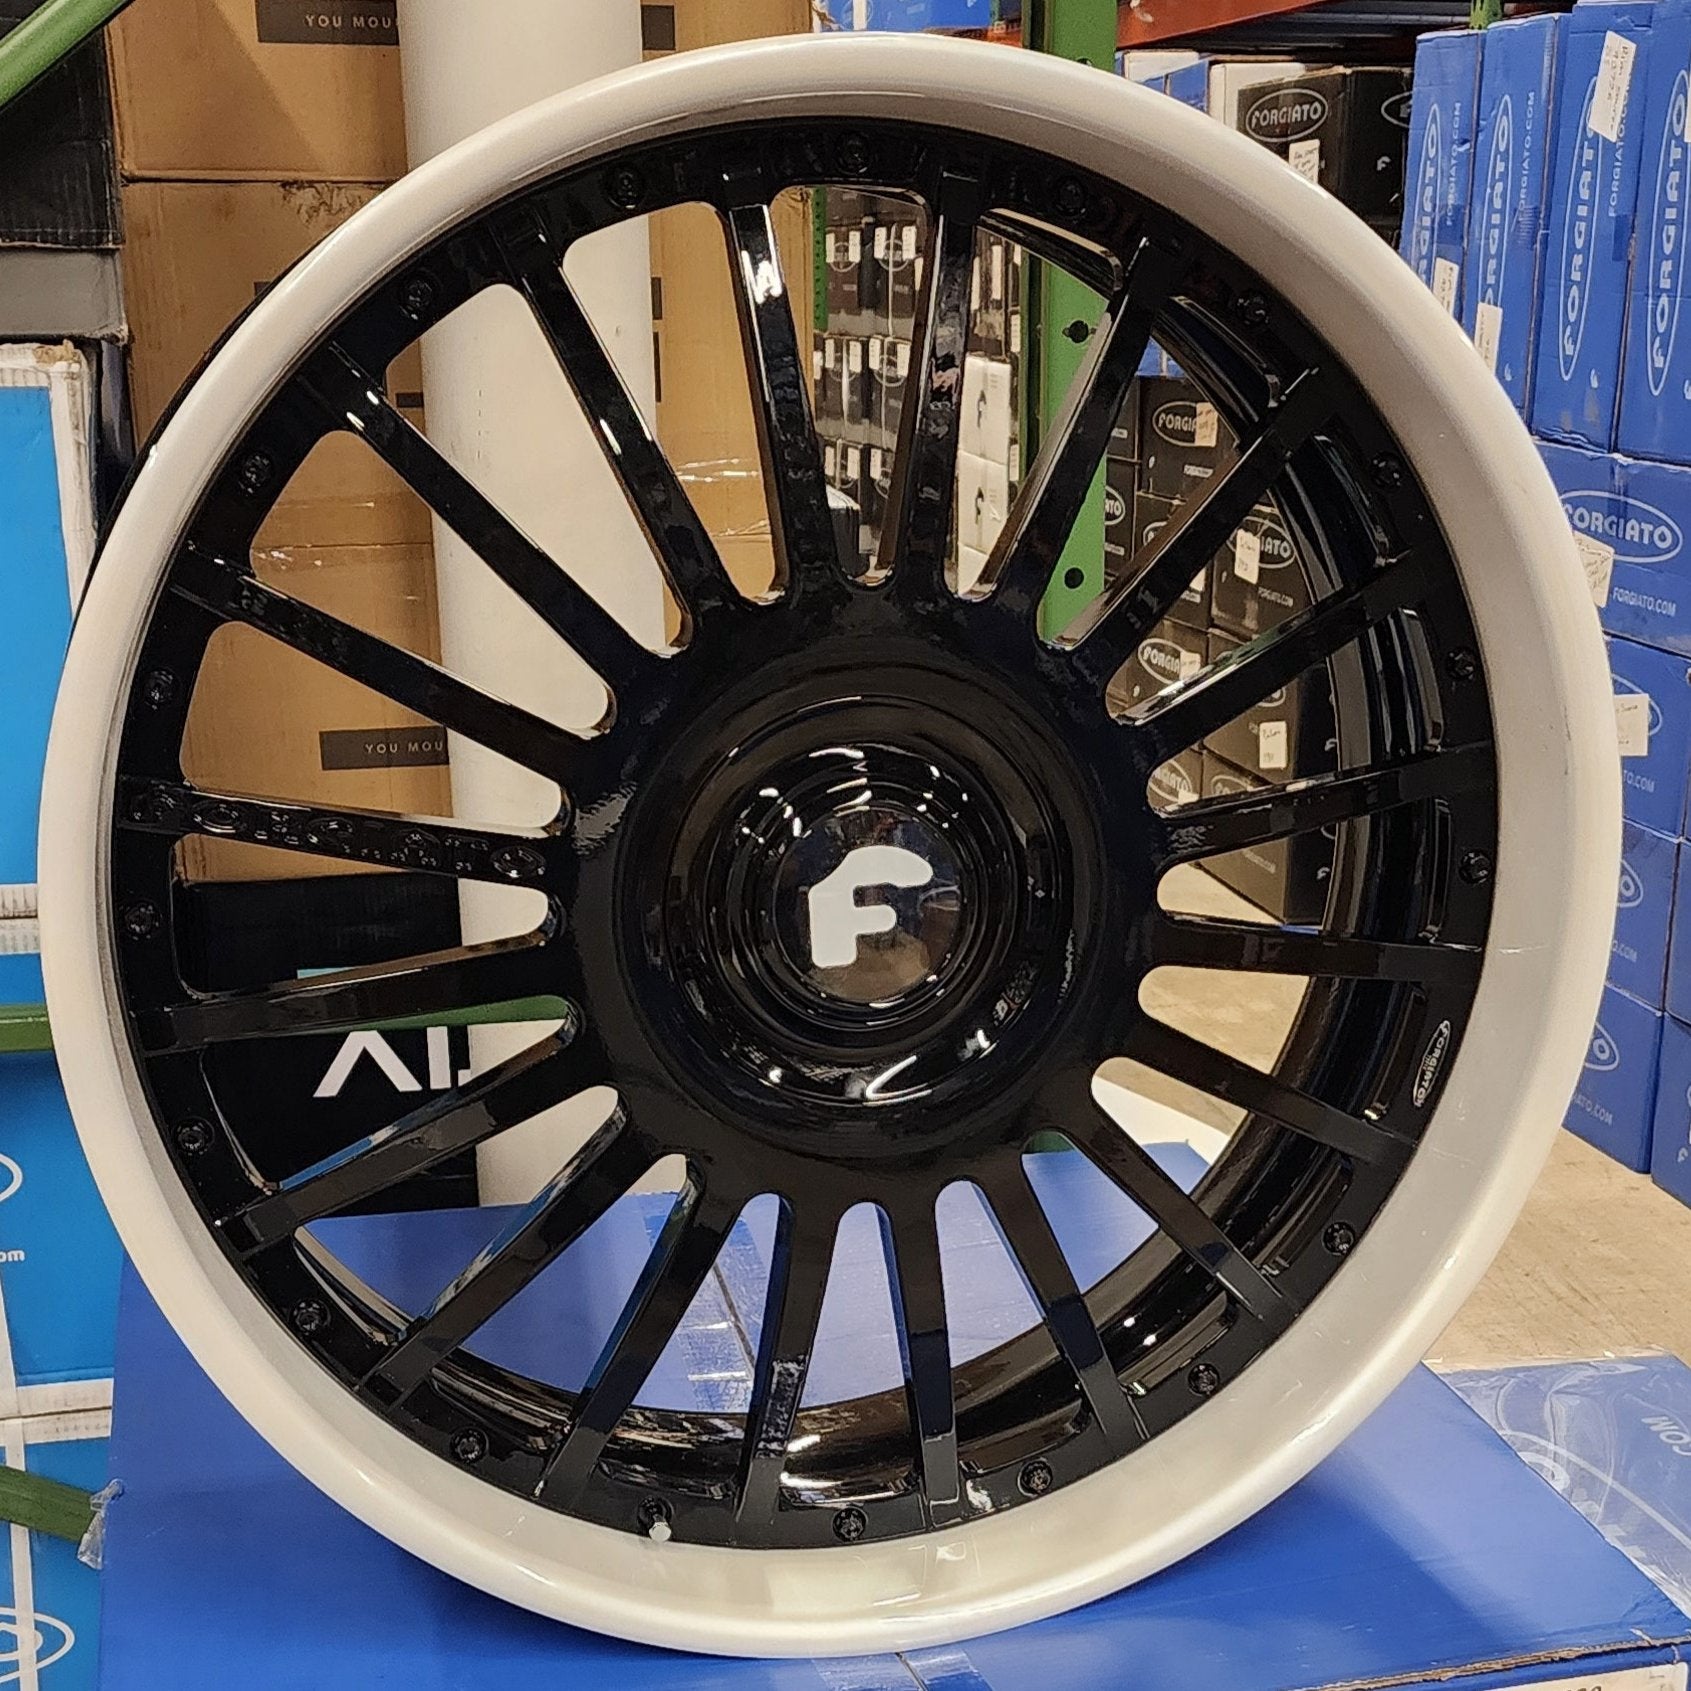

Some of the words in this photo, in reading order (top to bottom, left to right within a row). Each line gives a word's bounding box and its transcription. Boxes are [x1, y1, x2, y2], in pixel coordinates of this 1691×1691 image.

[305, 14, 342, 28] YOU
[1251, 101, 1322, 129] FORGIATO
[1519, 91, 1535, 211] ORGIATO.COM
[1608, 86, 1630, 217] FORGIATO.C
[1653, 92, 1685, 369] FORGIATO
[1613, 586, 1676, 617] FORGIATO.COM
[365, 743, 398, 754] YOU
[808, 845, 933, 968] F
